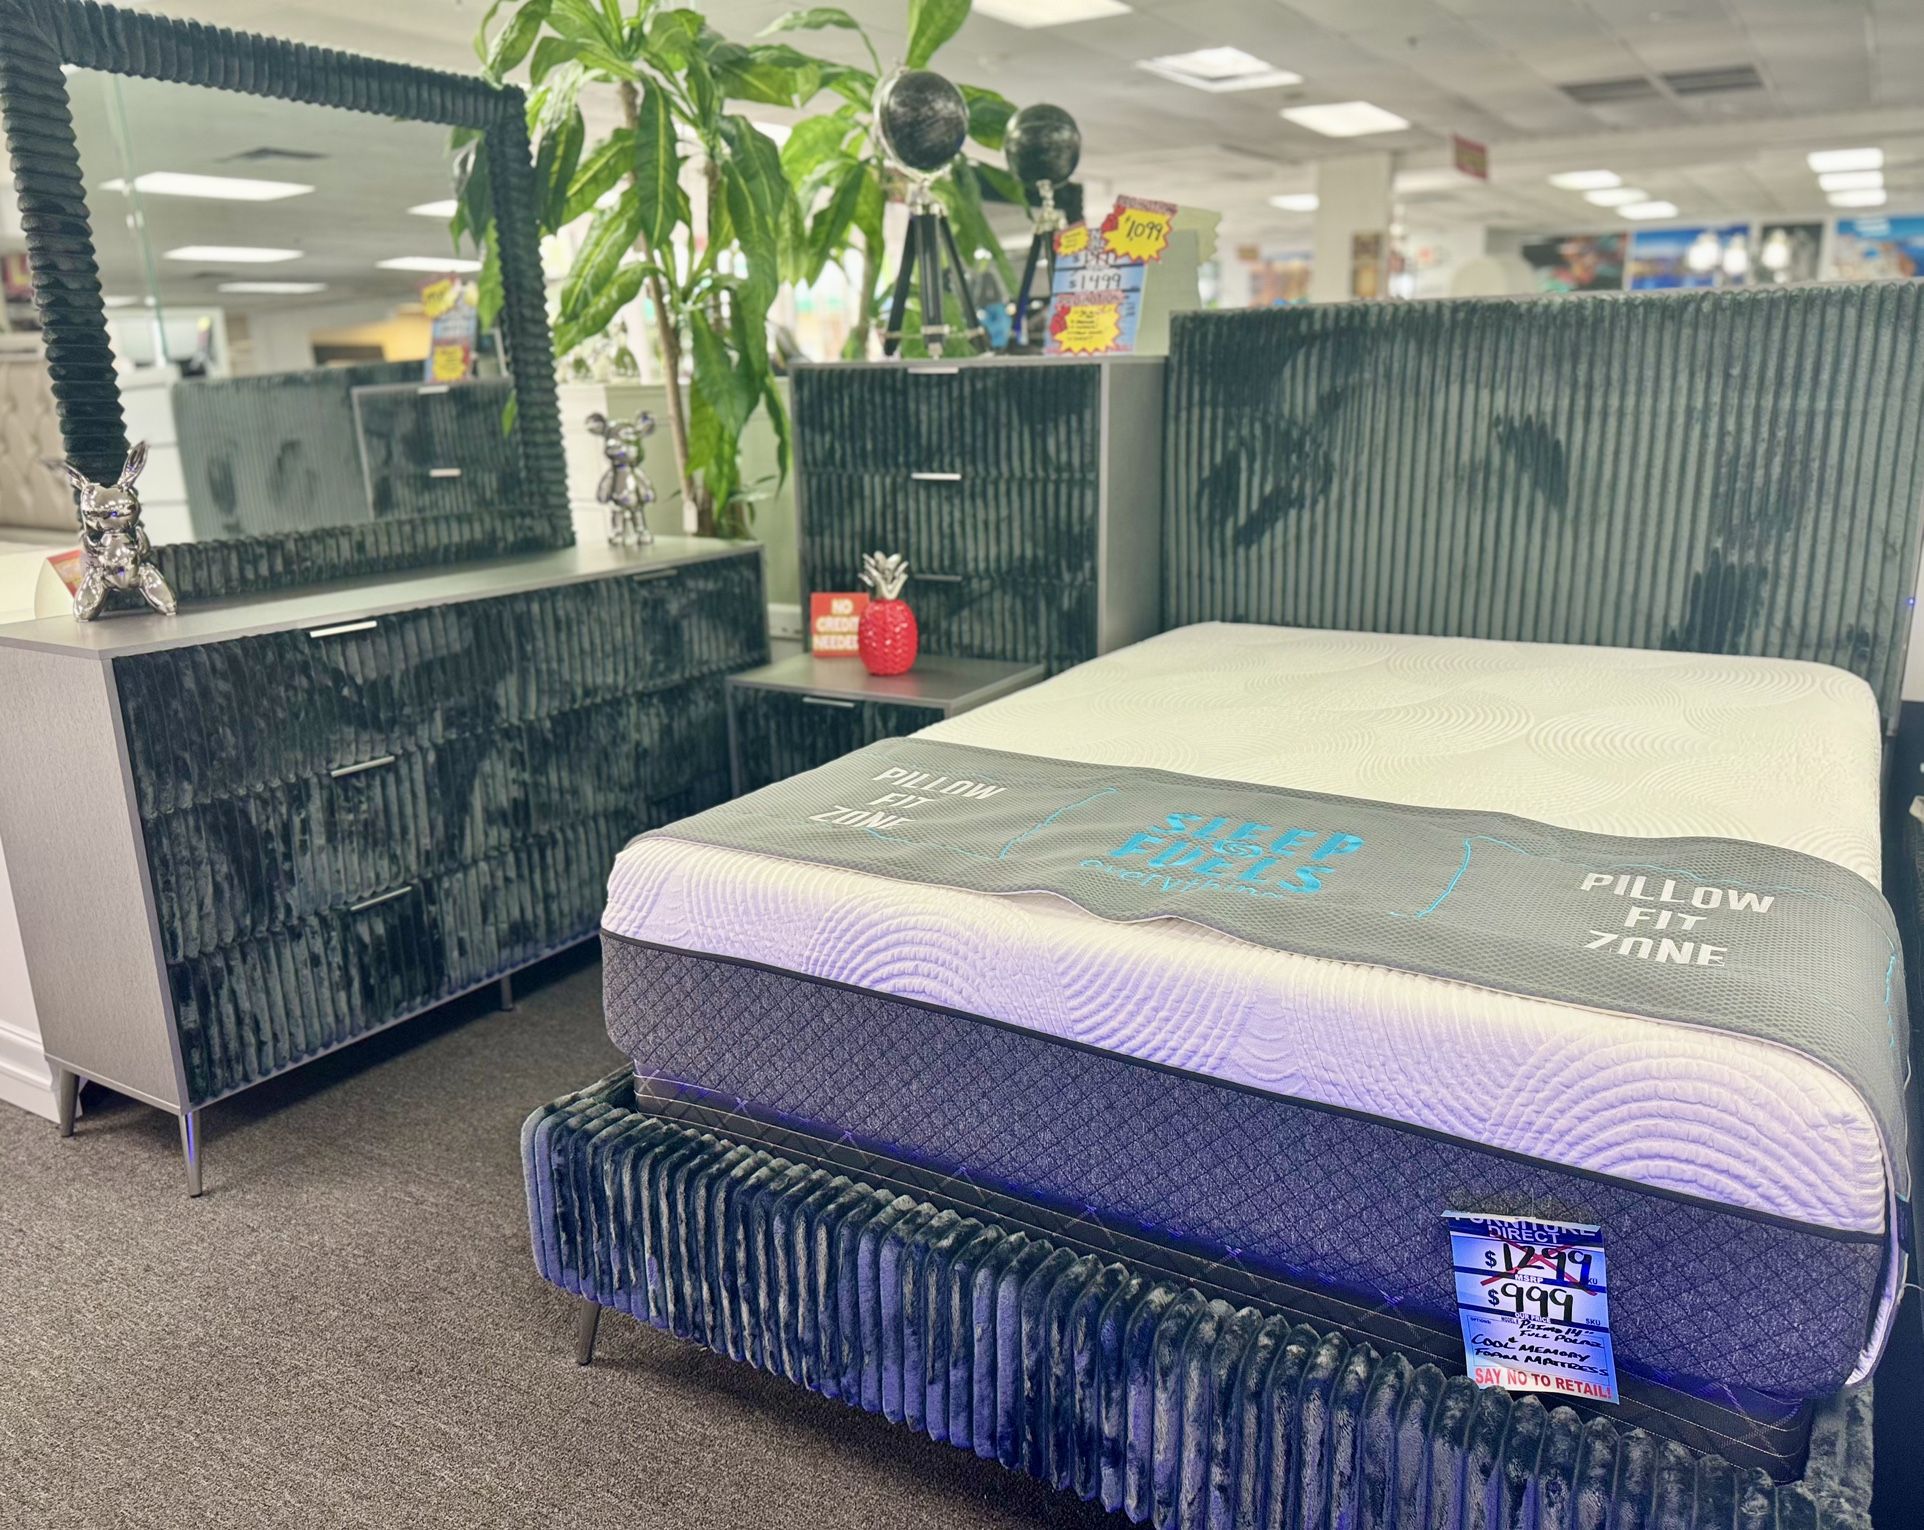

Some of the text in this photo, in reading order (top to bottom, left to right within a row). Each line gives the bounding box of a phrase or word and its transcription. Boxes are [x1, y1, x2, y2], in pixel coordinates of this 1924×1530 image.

[871, 766, 1007, 799] PILLOW
[867, 792, 936, 809] FIT
[807, 805, 916, 829] ZONE
[1579, 872, 1775, 913] PILLOW
[1623, 905, 1708, 930] FIT
[1583, 930, 1728, 967] ZONE
[1488, 1225, 1560, 1243] DIRECT
[1515, 1274, 1544, 1283] MSRP
[1515, 1311, 1530, 1320] OUR
[1585, 1318, 1601, 1326] SKU
[1471, 1333, 1591, 1362] COOL MEMORY
[1475, 1367, 1612, 1399] SAY NO TO RETAIL!
